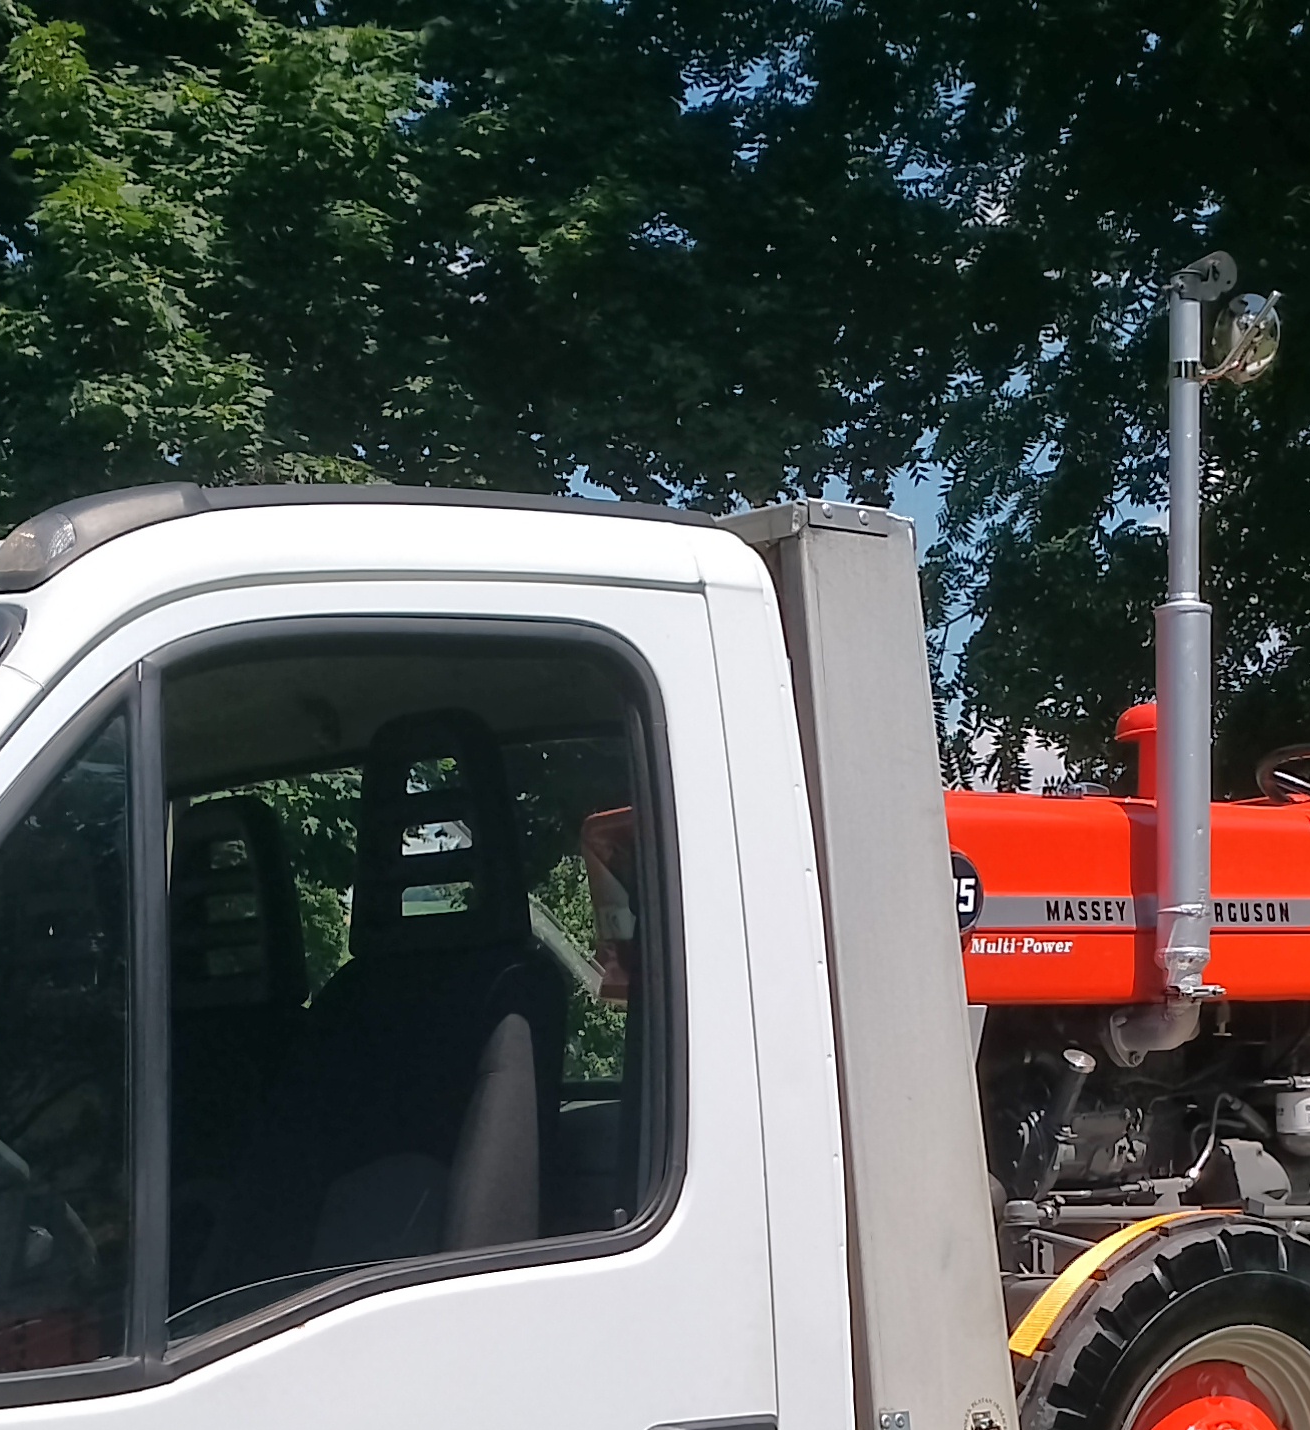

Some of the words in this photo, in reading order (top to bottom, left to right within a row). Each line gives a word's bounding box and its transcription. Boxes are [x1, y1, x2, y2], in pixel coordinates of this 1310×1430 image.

[1046, 900, 1126, 921] MASSEY
[1214, 902, 1290, 923] RGUSON
[970, 937, 1073, 954] Multi-Power
